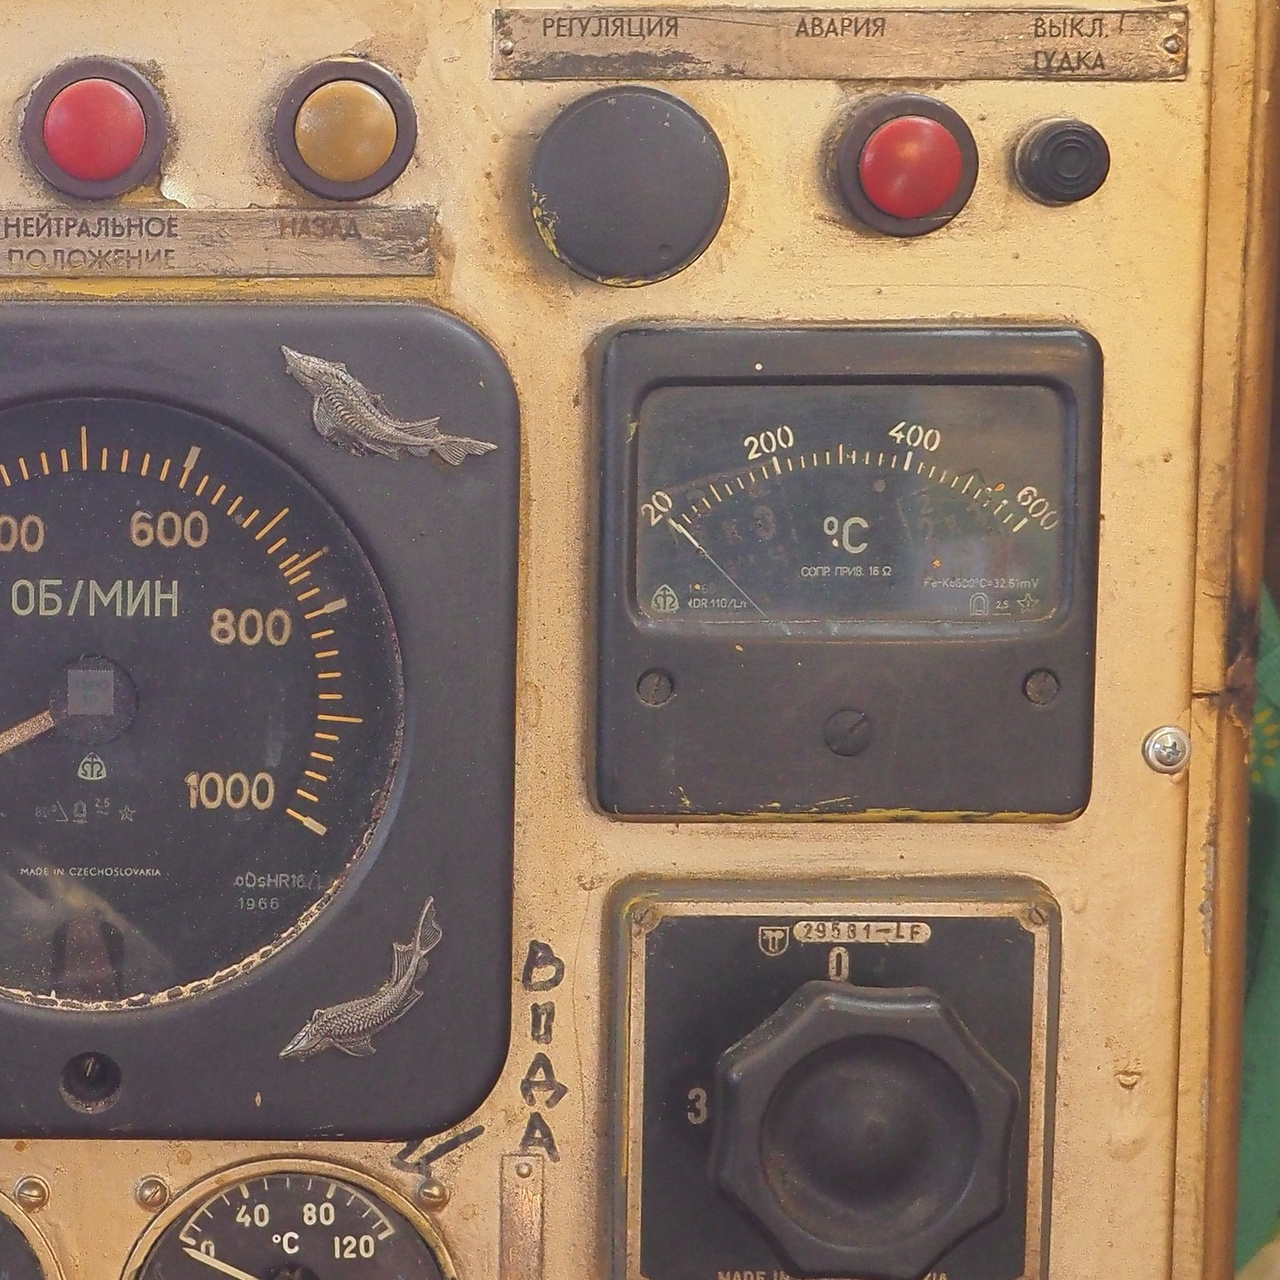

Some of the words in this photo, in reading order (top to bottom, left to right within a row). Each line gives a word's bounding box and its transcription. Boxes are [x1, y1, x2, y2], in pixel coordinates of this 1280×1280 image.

[542, 17, 679, 40] РЕГУЛЯЦИЯ
[795, 17, 887, 38] АВАРИЯ
[3, 214, 179, 239] НЕЙТРАЛЬНОЕ
[279, 217, 362, 242] НАЗАД
[7, 247, 176, 271] ПОЛОЖЕНИЕ
[744, 425, 794, 461] 200
[888, 421, 941, 452] 400
[640, 490, 673, 526] 20
[1017, 485, 1059, 531] 600
[129, 510, 209, 549] 600
[11, 578, 180, 618] ОБ/МИН
[210, 608, 293, 647] 800
[184, 771, 276, 811] 1000
[20, 867, 49, 876] MADE
[53, 867, 64, 876] IN
[68, 867, 161, 877] CZECHOSLOVAKIA
[828, 946, 850, 983] 0
[687, 1087, 708, 1125] 3
[236, 1204, 269, 1227] 40
[303, 1202, 335, 1225] 80
[334, 1235, 375, 1259] 120
